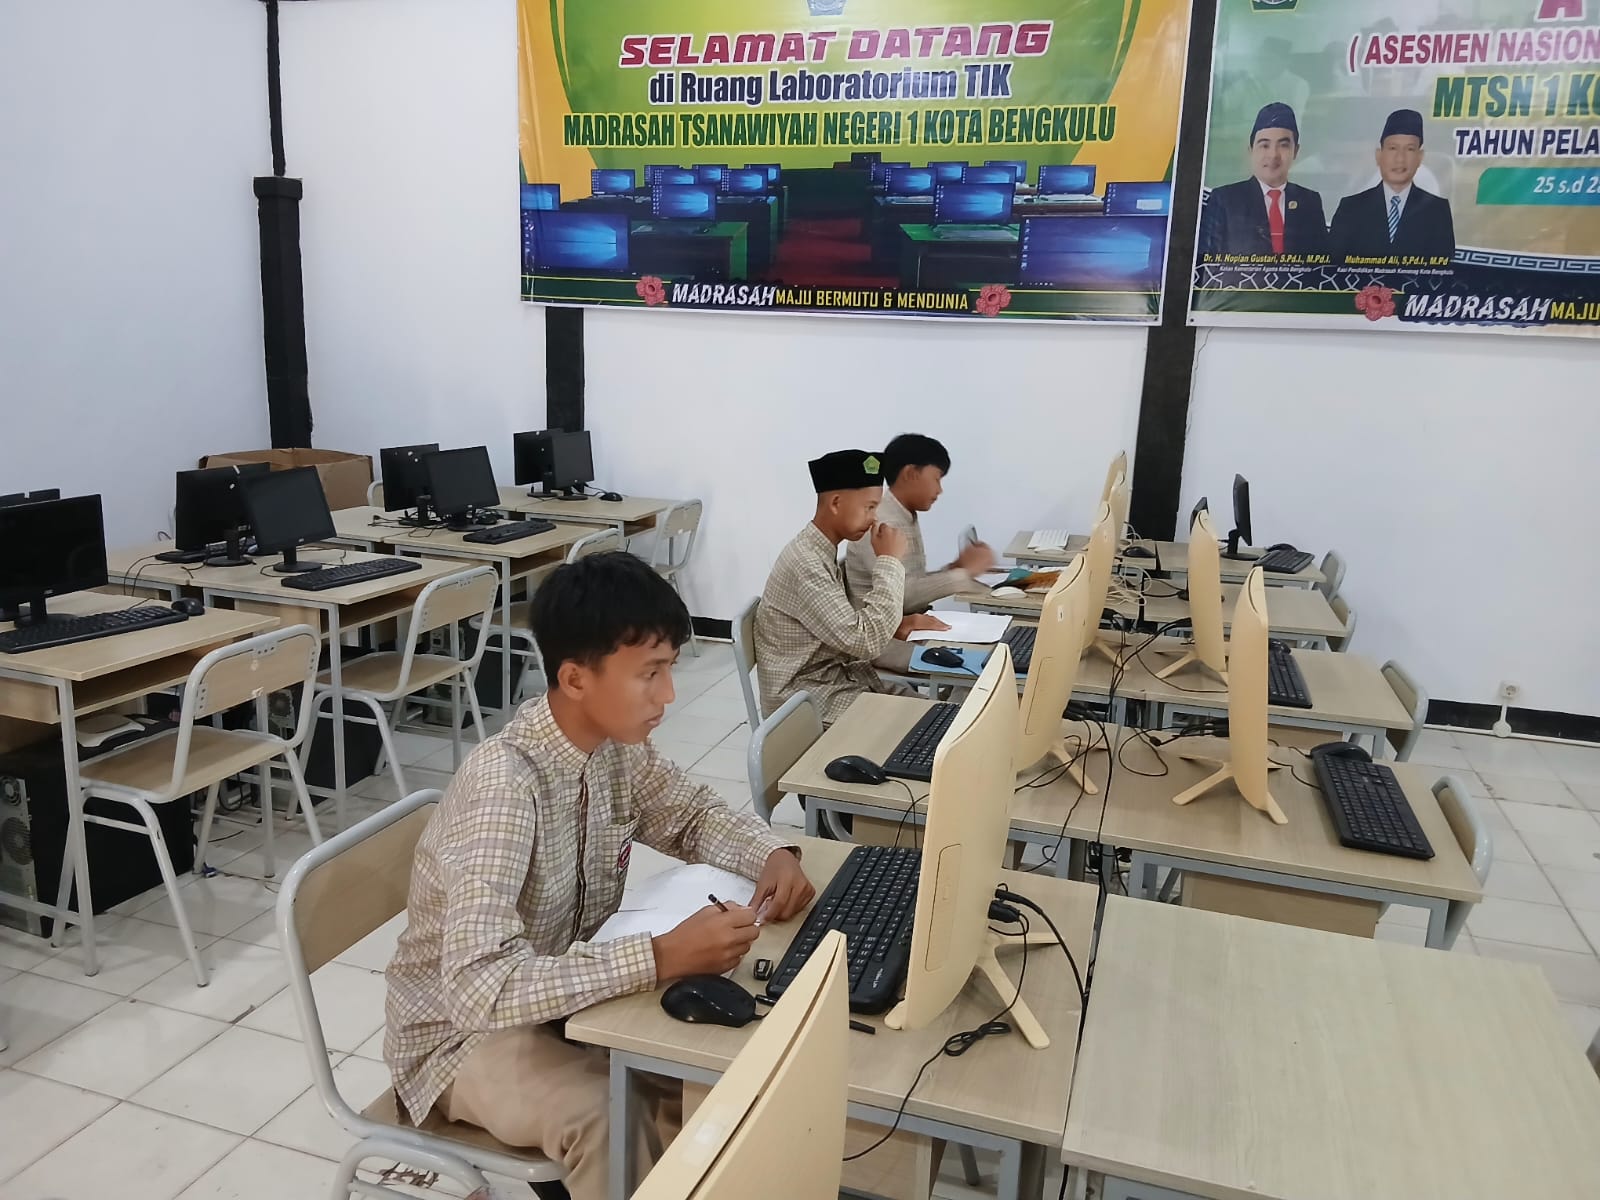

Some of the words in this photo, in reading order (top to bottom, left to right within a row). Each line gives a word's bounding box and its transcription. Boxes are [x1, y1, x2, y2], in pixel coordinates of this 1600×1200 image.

[620, 32, 837, 66] SELAMAT
[847, 23, 1051, 60] DATANG
[1364, 33, 1490, 65] ASESMEN
[649, 73, 674, 103] di
[681, 72, 763, 105] Ruang
[769, 66, 958, 102] Laboratorium
[964, 64, 1012, 98] TIK
[1433, 75, 1536, 118] MTSN
[1544, 74, 1559, 117] 1
[564, 114, 675, 146] MADRASAH
[680, 112, 818, 146] TSANAWIYAH
[823, 110, 900, 145] NEGERI
[907, 110, 918, 145] 1
[923, 108, 983, 145] KOTA
[988, 106, 1116, 144] BENGKULU
[1455, 129, 1535, 155] TAHUN
[1540, 128, 1600, 155] PELA
[1533, 176, 1556, 193] 25
[1557, 176, 1585, 193] s.d
[1345, 256, 1387, 264] Muhammad
[671, 282, 777, 306] MADRASAH
[776, 290, 812, 306] MAJU
[816, 291, 878, 308] BERMUTU
[883, 292, 893, 308] &
[897, 292, 969, 310] MENDUNIA
[1405, 294, 1552, 321] MADRASAH
